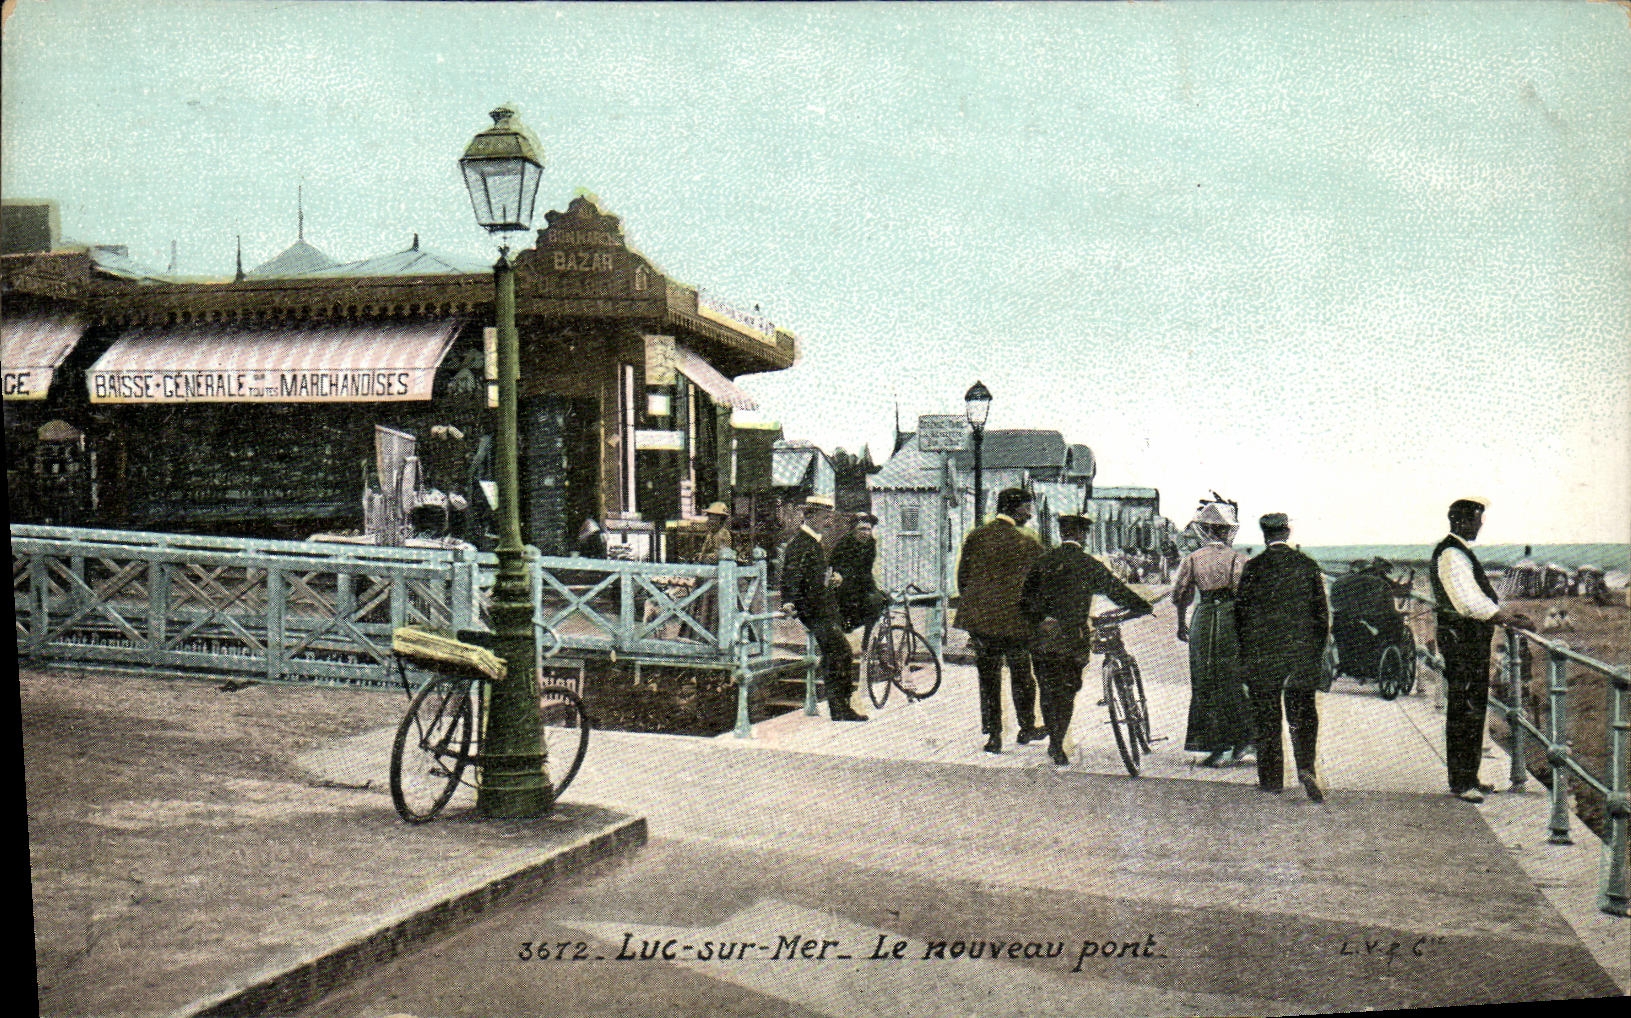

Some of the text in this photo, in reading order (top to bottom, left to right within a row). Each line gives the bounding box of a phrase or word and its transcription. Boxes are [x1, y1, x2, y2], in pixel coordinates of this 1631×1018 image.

[553, 250, 614, 271] BAZAR
[4, 372, 31, 395] GE
[95, 375, 154, 398] BAISSE
[280, 372, 409, 397] MARCHANDISES
